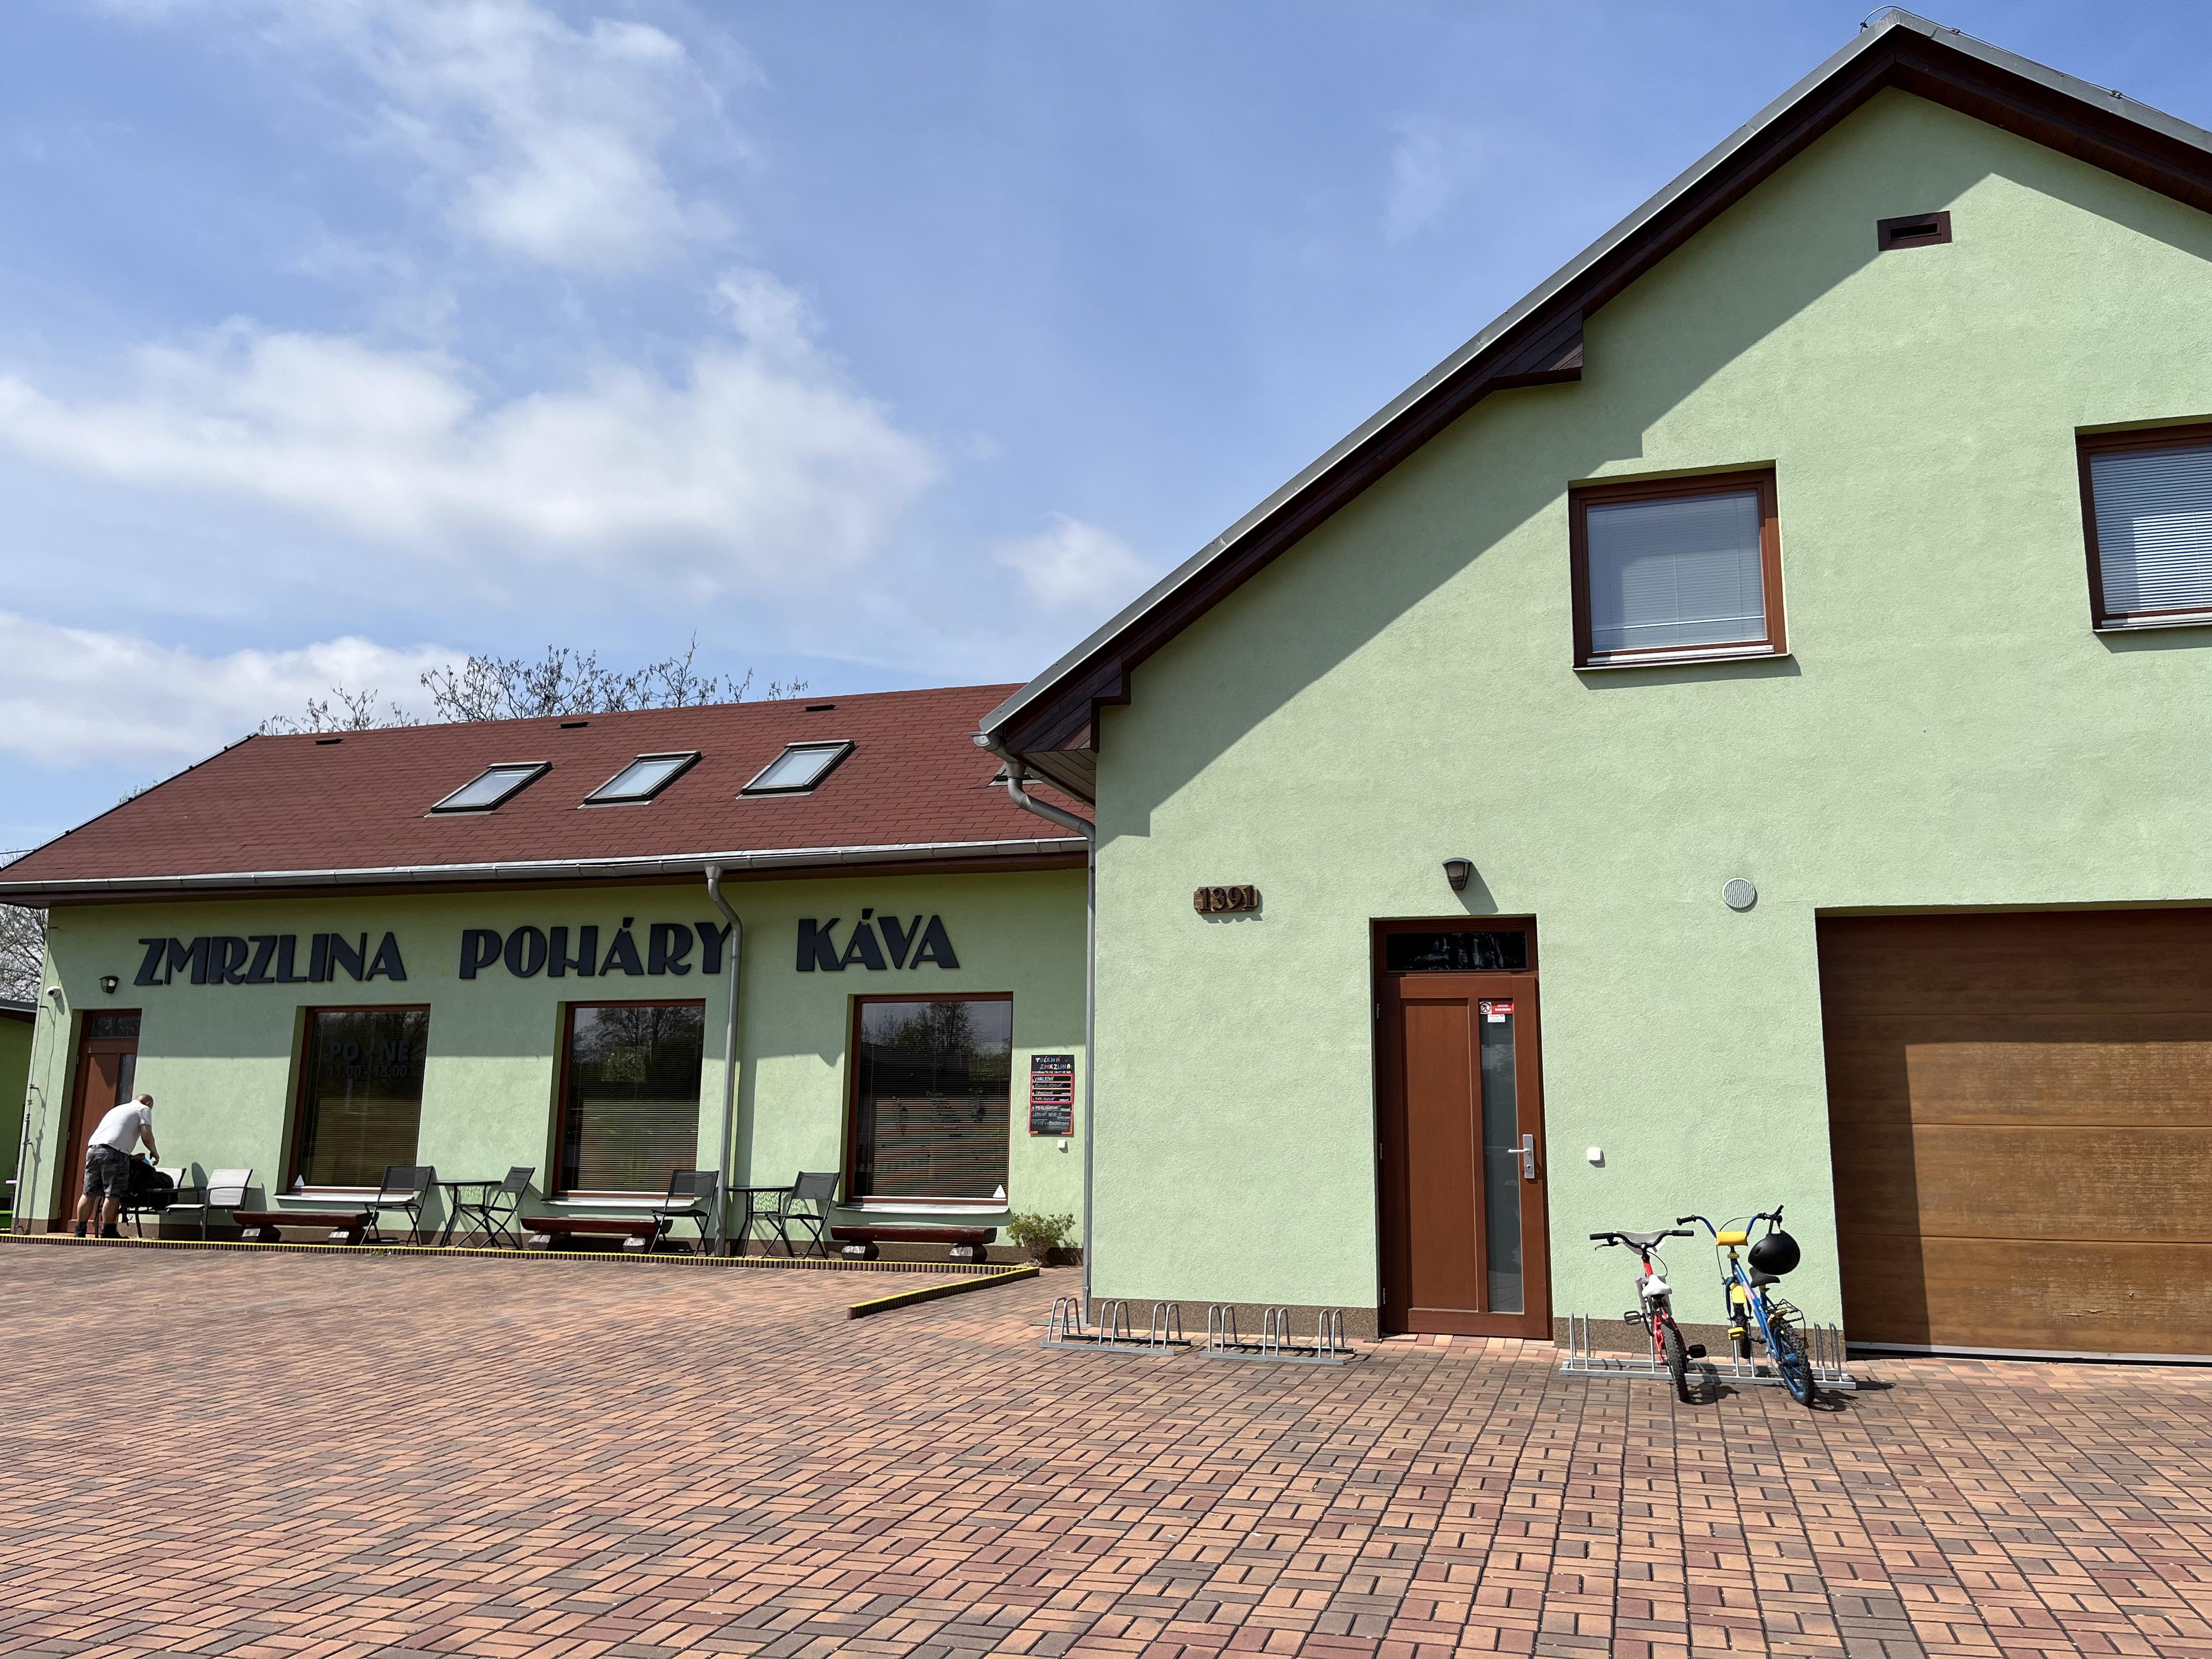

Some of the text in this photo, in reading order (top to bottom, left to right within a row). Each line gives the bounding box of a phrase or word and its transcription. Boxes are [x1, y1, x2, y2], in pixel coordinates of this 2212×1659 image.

[1197, 885, 1256, 911] 1391
[133, 908, 961, 985] ZMRZLINA POHÁRY KÁVA
[329, 1041, 359, 1062] PO
[380, 1040, 409, 1061] NE
